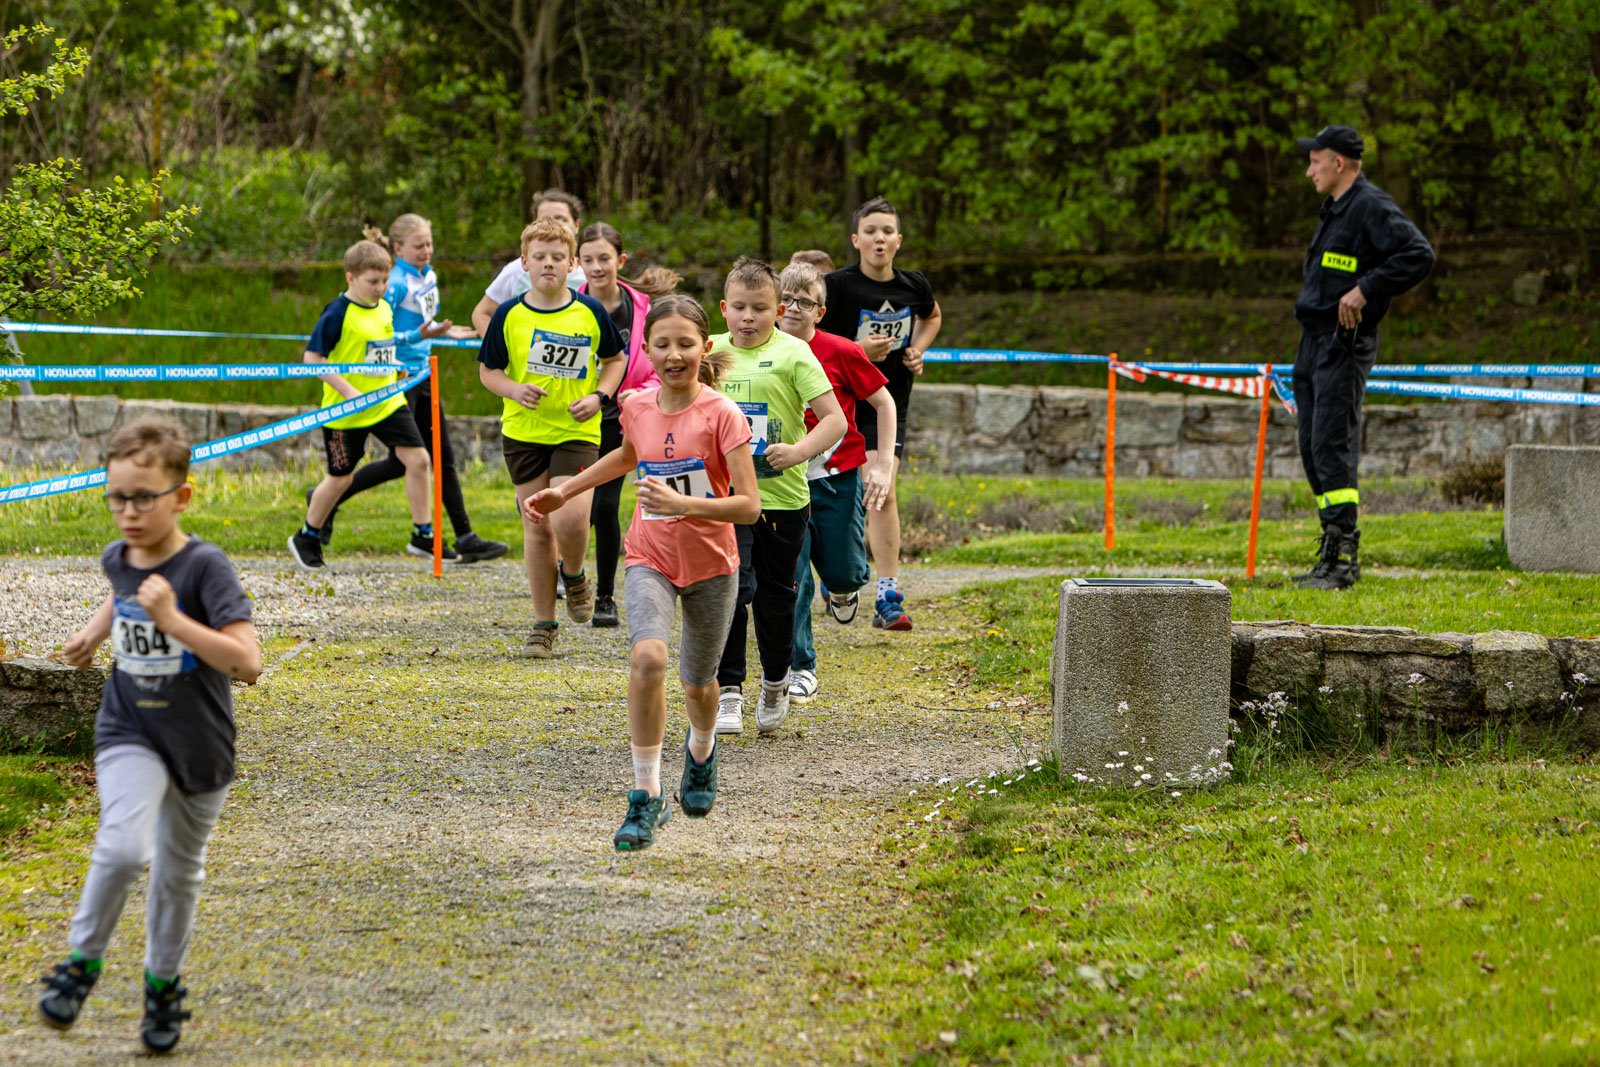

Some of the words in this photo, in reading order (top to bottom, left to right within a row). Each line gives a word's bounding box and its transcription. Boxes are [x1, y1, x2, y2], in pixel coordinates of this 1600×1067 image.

[869, 321, 903, 339] 332
[542, 344, 579, 367] 327
[44, 367, 96, 379] DECATHLON
[104, 367, 156, 379] DECATHLON
[165, 367, 217, 378] DECATHLON
[226, 367, 279, 377] DECATHLON
[1398, 383, 1452, 395] DECATHLON
[1460, 386, 1513, 398] DECATHLON
[1521, 390, 1575, 403] DECATHLON
[120, 621, 170, 656] 364
